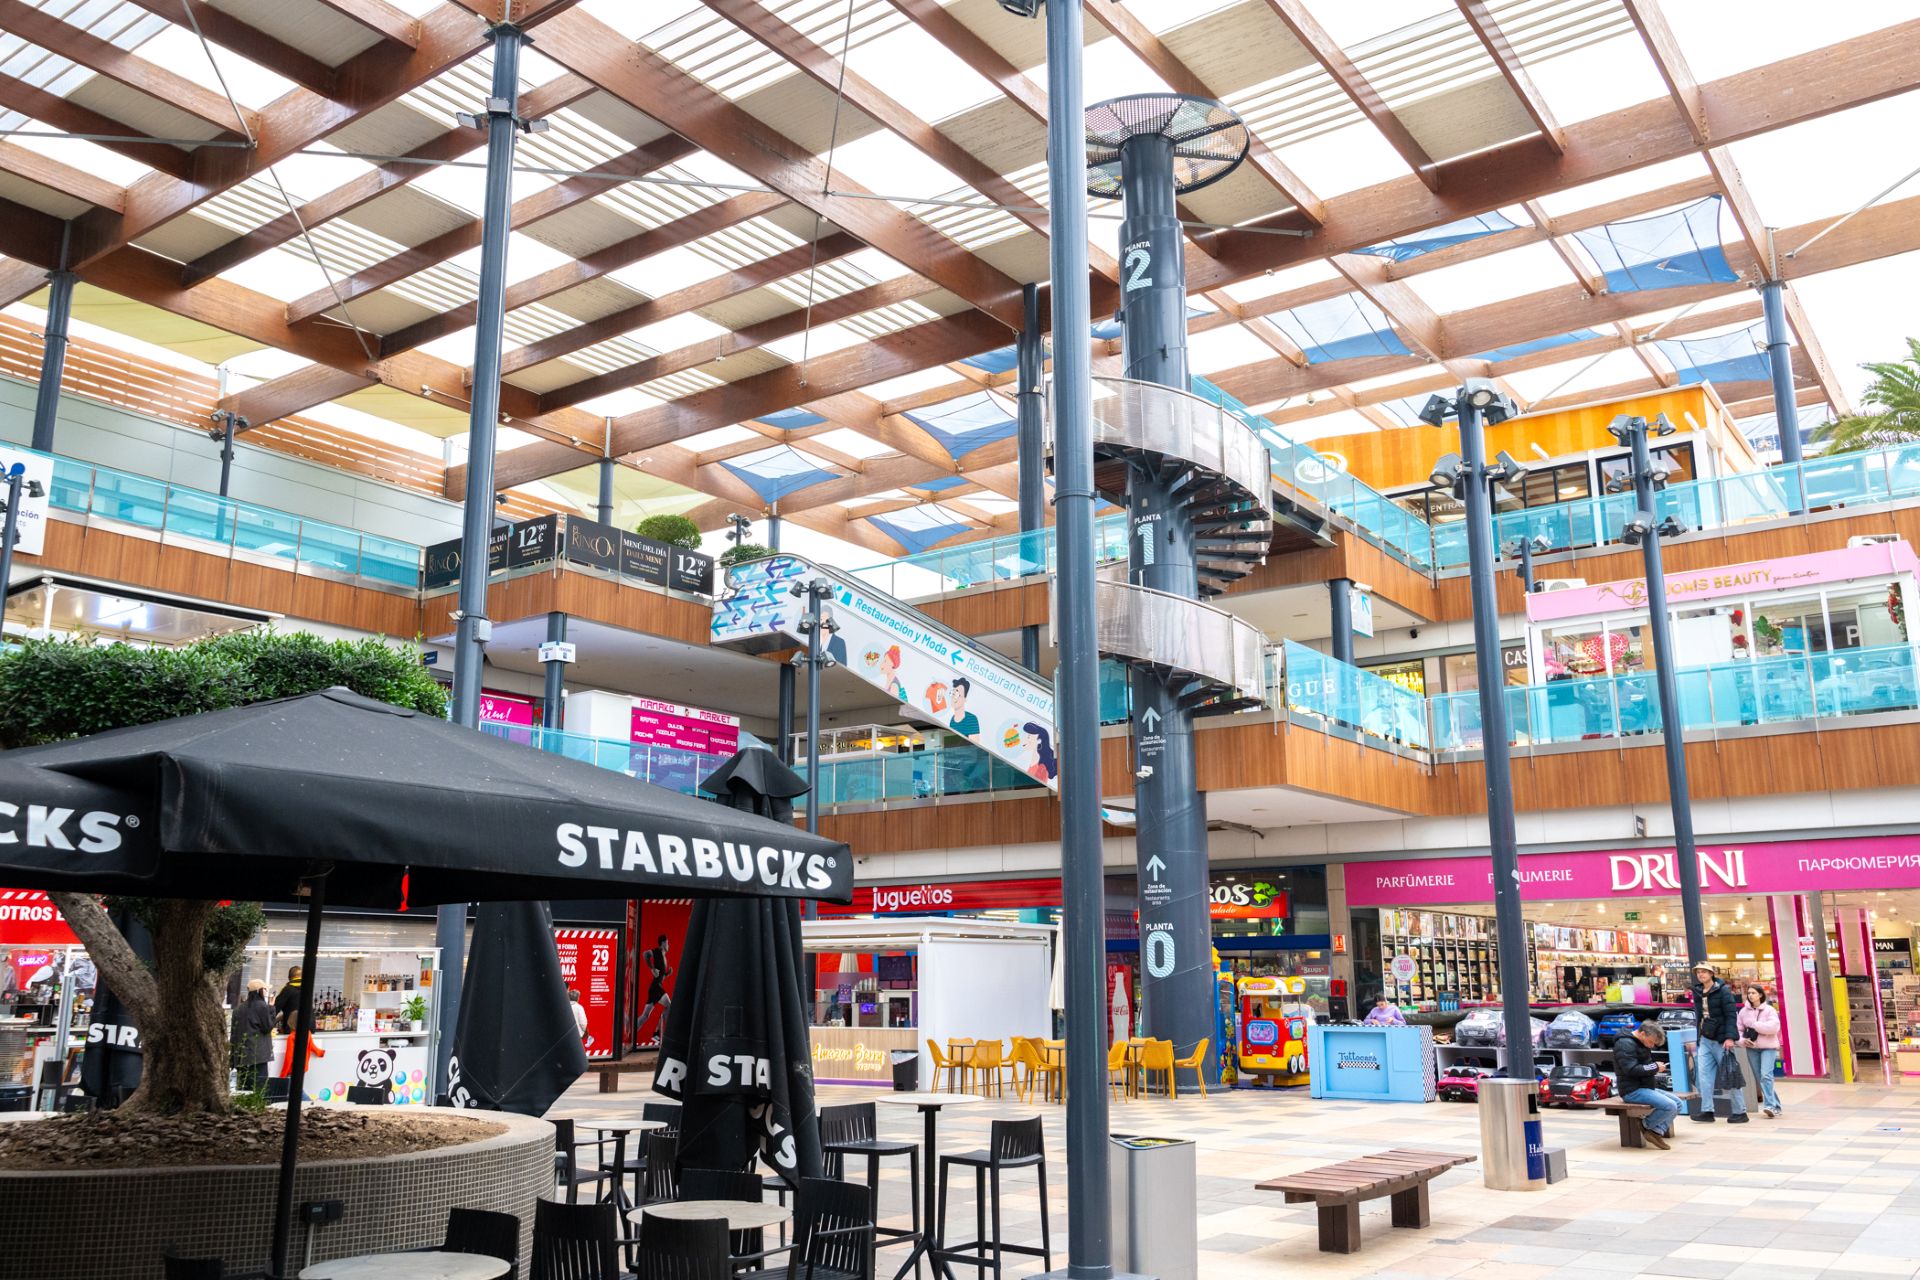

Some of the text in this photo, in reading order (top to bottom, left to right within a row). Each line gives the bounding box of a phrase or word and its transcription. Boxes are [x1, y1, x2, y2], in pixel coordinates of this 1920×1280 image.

[1125, 241, 1151, 253] PLANTA
[1125, 249, 1153, 293] 2
[1134, 514, 1161, 525] PLANTA
[642, 543, 656, 554] DEL
[655, 546, 667, 558] DÍA
[1137, 522, 1155, 566] 1
[1714, 568, 1771, 590] BEAUTY
[855, 598, 914, 638] Restauración
[913, 632, 921, 643] y
[922, 633, 948, 656] Moda
[967, 657, 1026, 698] Restaurants
[1026, 692, 1047, 710] and
[699, 710, 731, 724] MARKET
[1609, 849, 1748, 892] DRUNI
[1376, 873, 1455, 889] PARFÜMERIE
[1145, 922, 1174, 931] PLANTA
[1146, 930, 1176, 979] 0
[1875, 942, 1895, 951] MAN
[592, 949, 610, 966] 29
